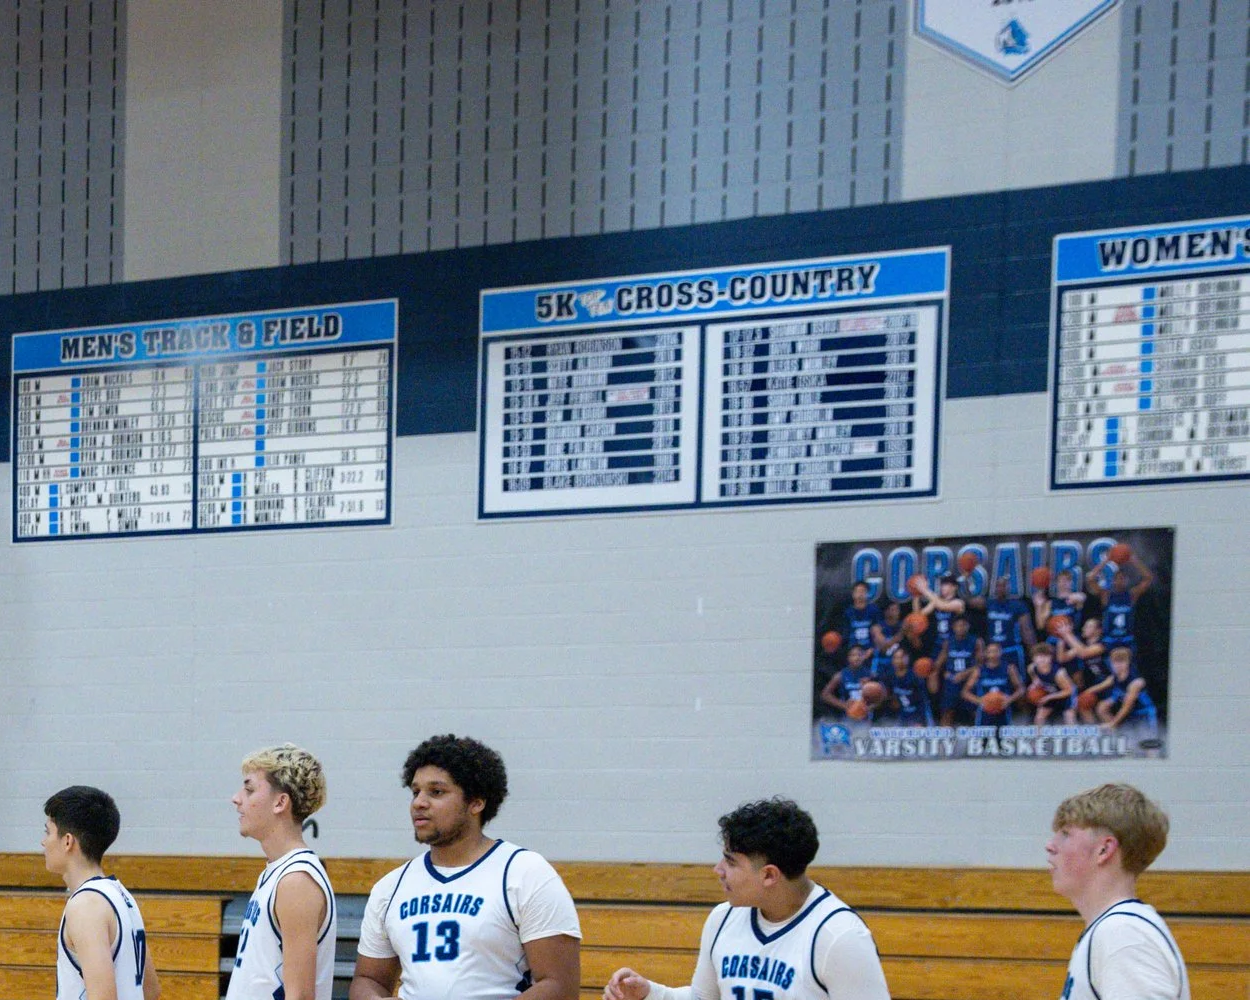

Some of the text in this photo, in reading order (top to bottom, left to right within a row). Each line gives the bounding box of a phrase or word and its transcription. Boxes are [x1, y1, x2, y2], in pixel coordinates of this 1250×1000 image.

[536, 264, 879, 319] 5K CROSS-COUNTRY
[60, 314, 342, 363] MEN'S TRACK & FIELD
[111, 433, 142, 445] ROBINSON
[111, 448, 142, 460] ROBINSON
[102, 463, 135, 476] LAWRENCE
[117, 507, 141, 518] MILLER
[851, 538, 1119, 604] CORSAIRS
[851, 735, 1131, 758] VARSITY BASKETBALL
[399, 892, 485, 920] CORSAIRS
[411, 919, 461, 963] 13
[721, 955, 796, 991] CORSAIRS
